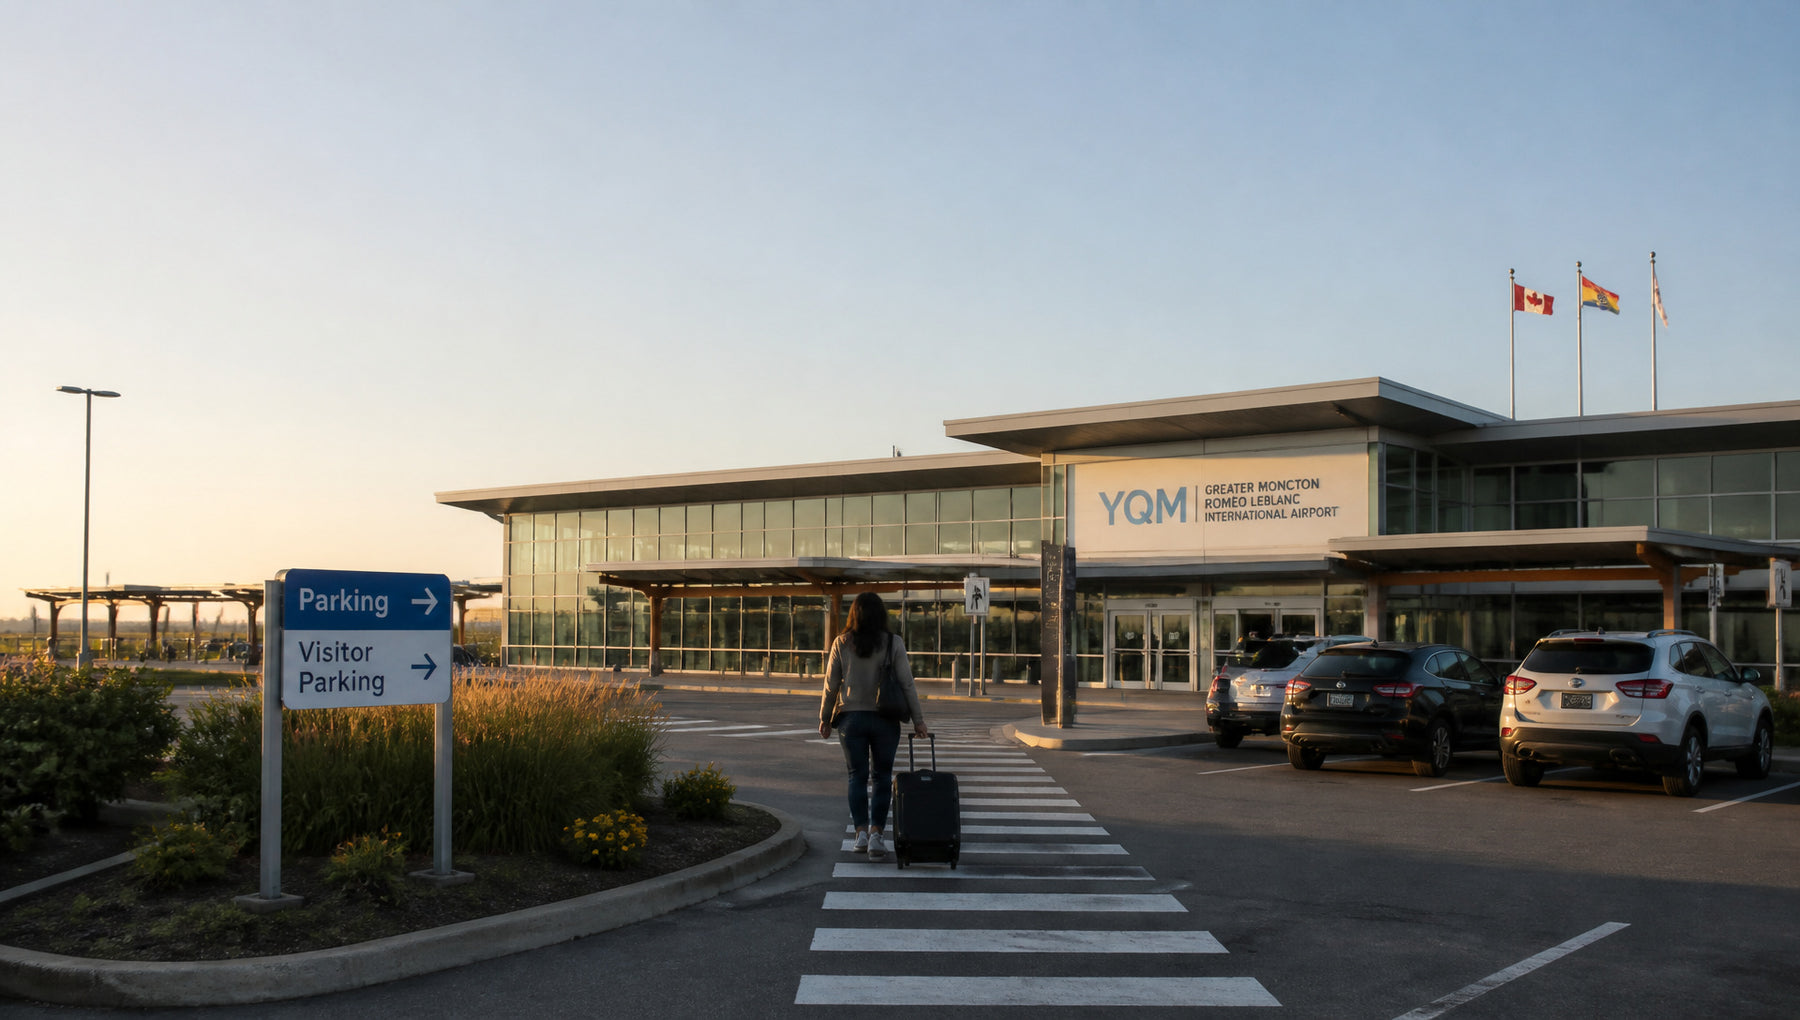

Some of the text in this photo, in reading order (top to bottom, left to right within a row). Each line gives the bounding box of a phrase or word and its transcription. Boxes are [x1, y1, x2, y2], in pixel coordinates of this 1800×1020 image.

[1205, 478, 1320, 495] GREATER MONCTON
[1099, 486, 1187, 526] YQM
[1251, 493, 1300, 507] LEBLANC
[1204, 506, 1339, 522] INTERNATIONAL AIRPORT
[300, 587, 389, 618] Parking
[298, 641, 373, 663] Visitor
[299, 670, 385, 697] Parking
